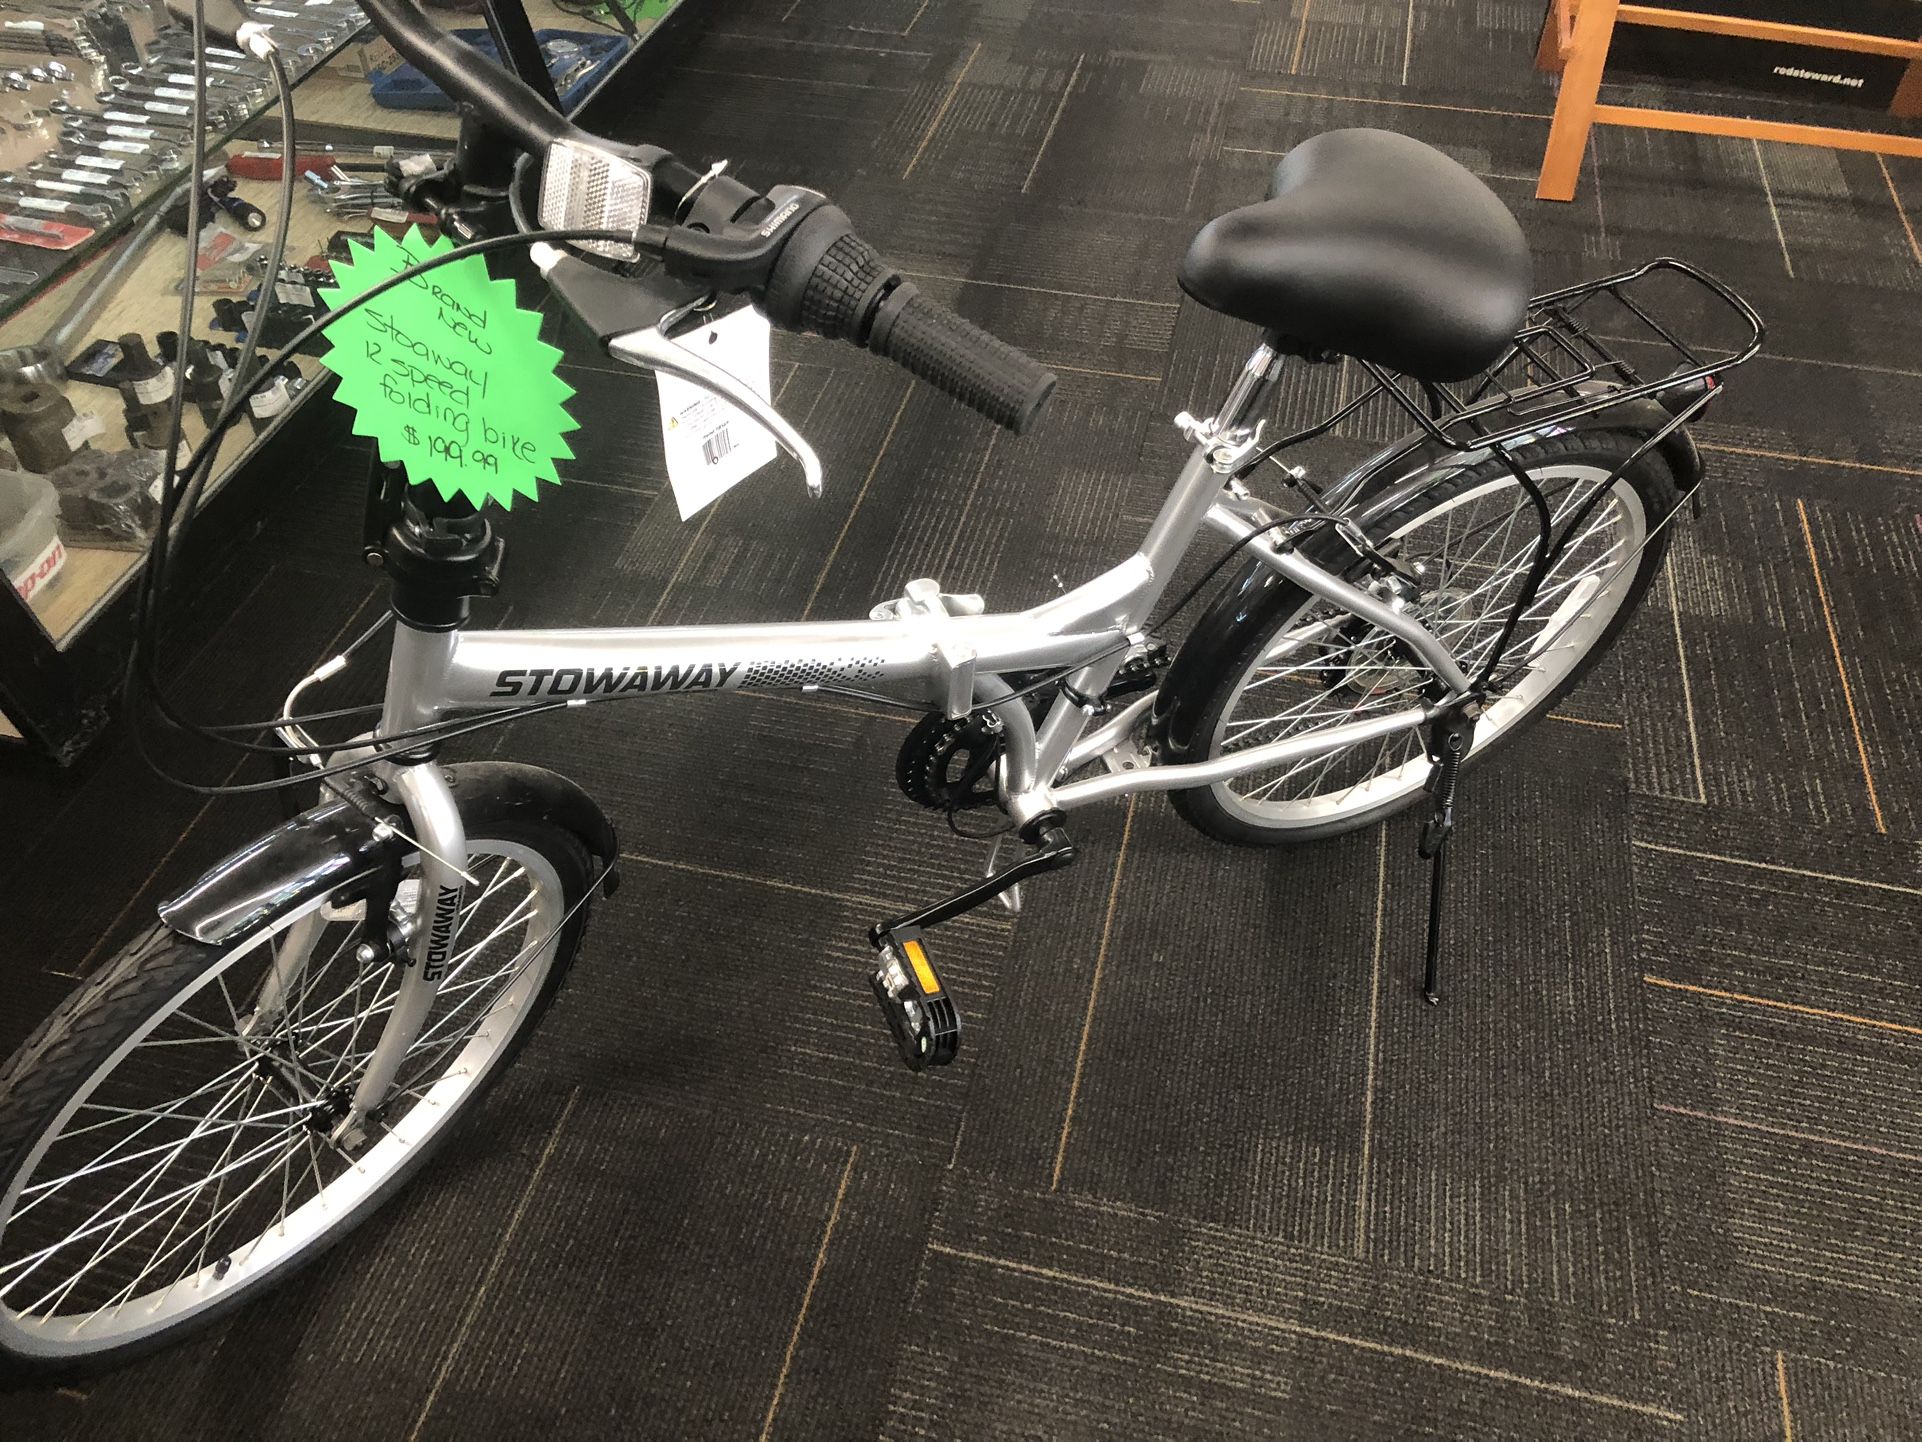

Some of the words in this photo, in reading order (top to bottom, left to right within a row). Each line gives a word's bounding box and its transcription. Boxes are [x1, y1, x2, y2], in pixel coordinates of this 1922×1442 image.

[365, 340, 382, 365] 12
[482, 416, 536, 464] bike
[490, 661, 742, 697] STOWAWAY
[422, 884, 458, 982] STOWAWAY
